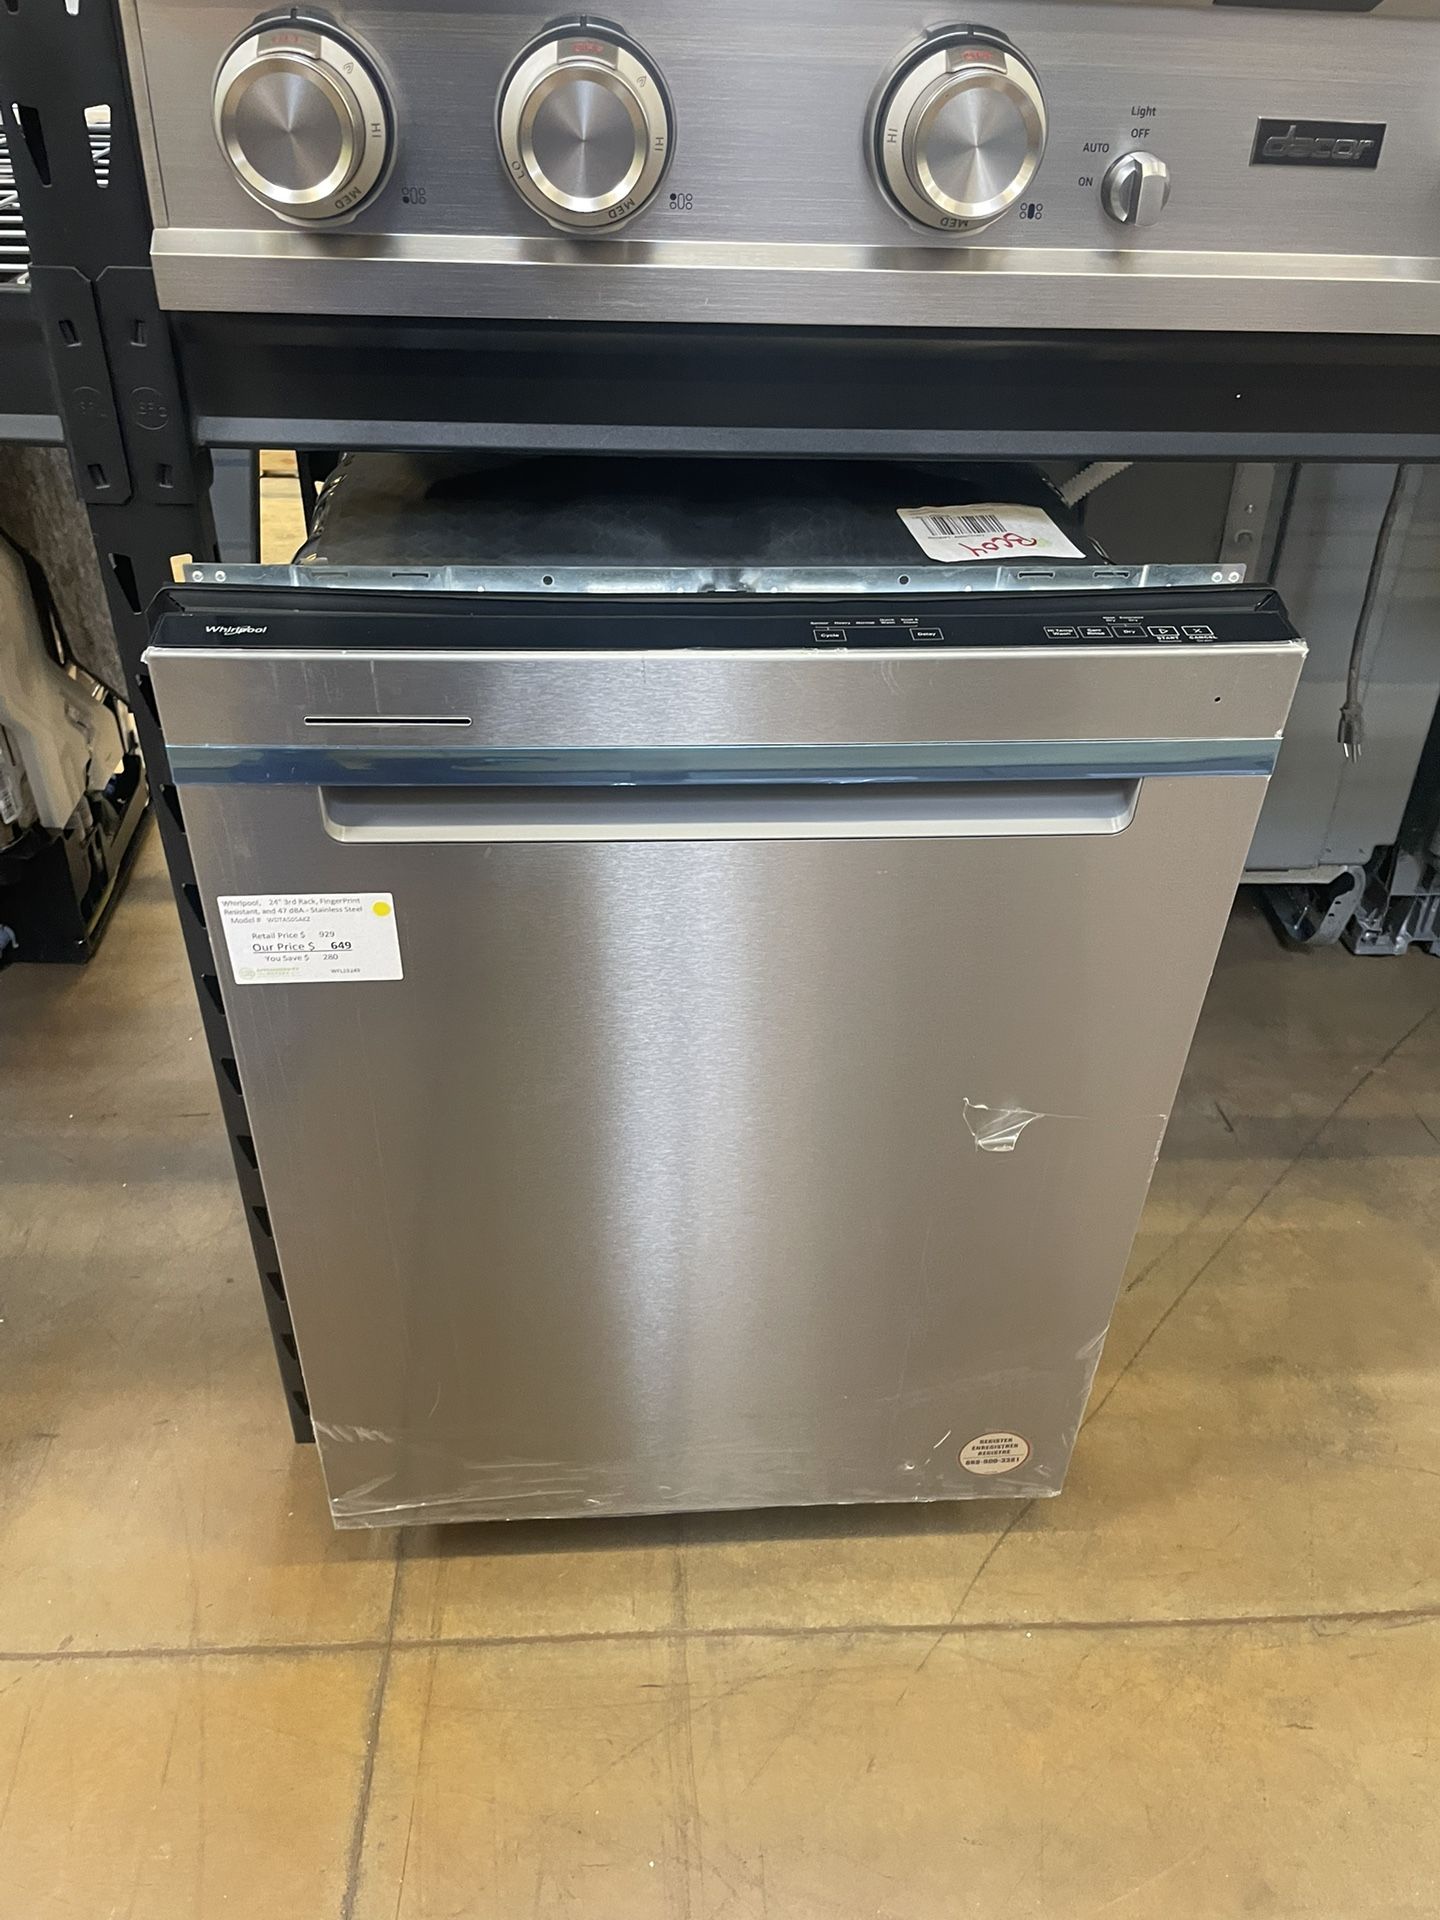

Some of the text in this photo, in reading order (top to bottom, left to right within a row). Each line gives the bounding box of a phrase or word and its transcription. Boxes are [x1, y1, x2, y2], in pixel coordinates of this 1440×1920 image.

[1131, 106, 1156, 118] Light
[370, 122, 381, 138] HI
[1130, 128, 1150, 138] OFF
[887, 128, 898, 144] HI
[655, 136, 665, 151] HI
[1083, 142, 1110, 153] AUTO
[511, 160, 525, 180] LO
[1078, 176, 1093, 187] ON
[334, 186, 362, 209] MED
[608, 198, 636, 219] MED
[940, 216, 969, 228] MED
[205, 625, 268, 636] Whirlpool
[310, 906, 343, 914] Stainless
[344, 905, 363, 913] Steel
[252, 930, 335, 940] Retail Price $ 929
[252, 941, 352, 952] Our Price $ 649
[323, 953, 339, 961] 280
